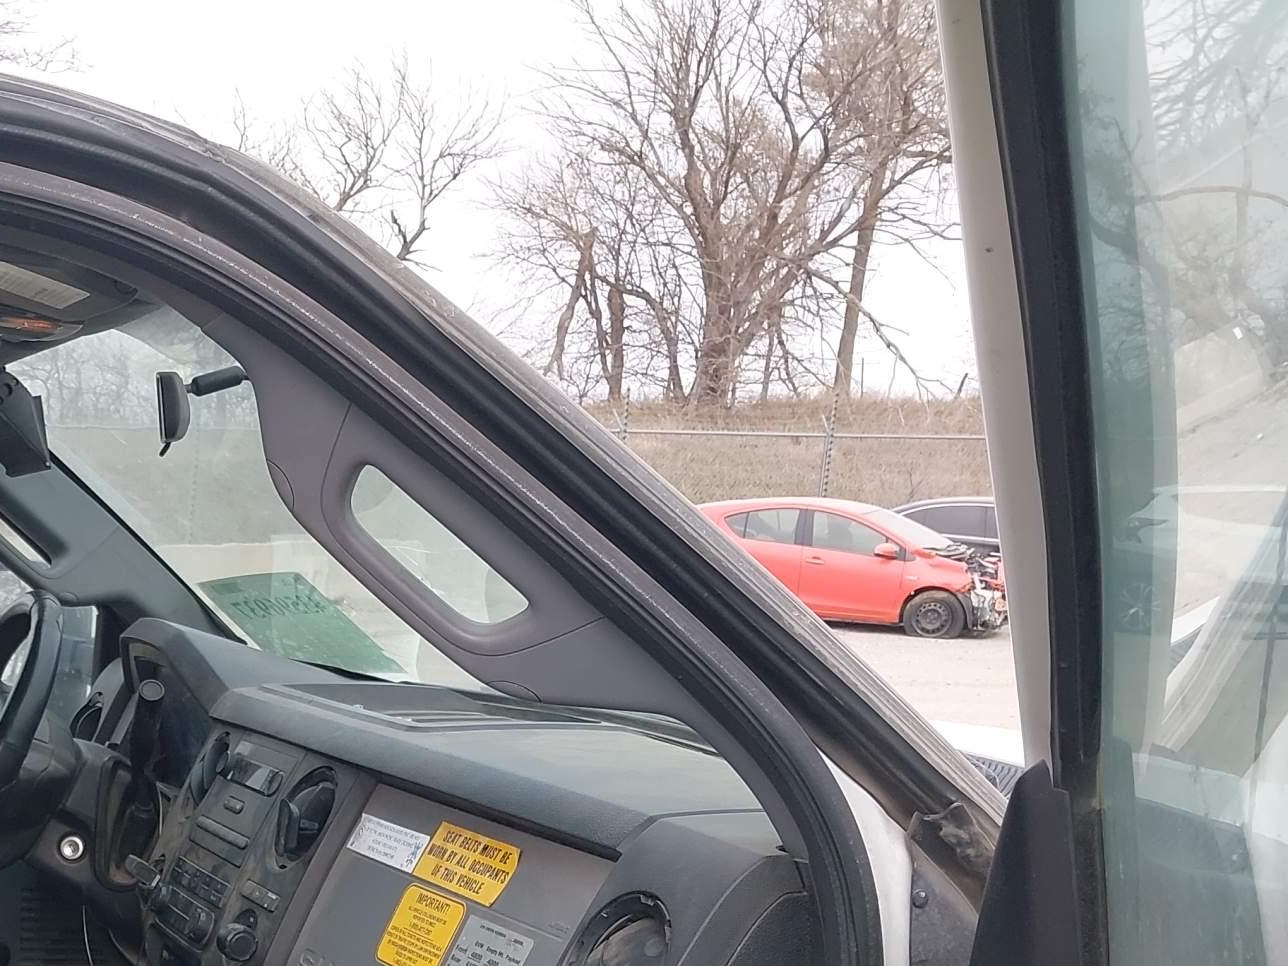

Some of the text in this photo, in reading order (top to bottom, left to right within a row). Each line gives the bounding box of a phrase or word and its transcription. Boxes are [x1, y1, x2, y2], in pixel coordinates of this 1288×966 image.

[443, 830, 512, 864] SEAT BELTS MUST BE
[427, 843, 509, 884] WORN BY ALL OCCUPANTS
[431, 863, 485, 894] OF THIS VEHICLE
[416, 892, 451, 915] IMPORTANT!
